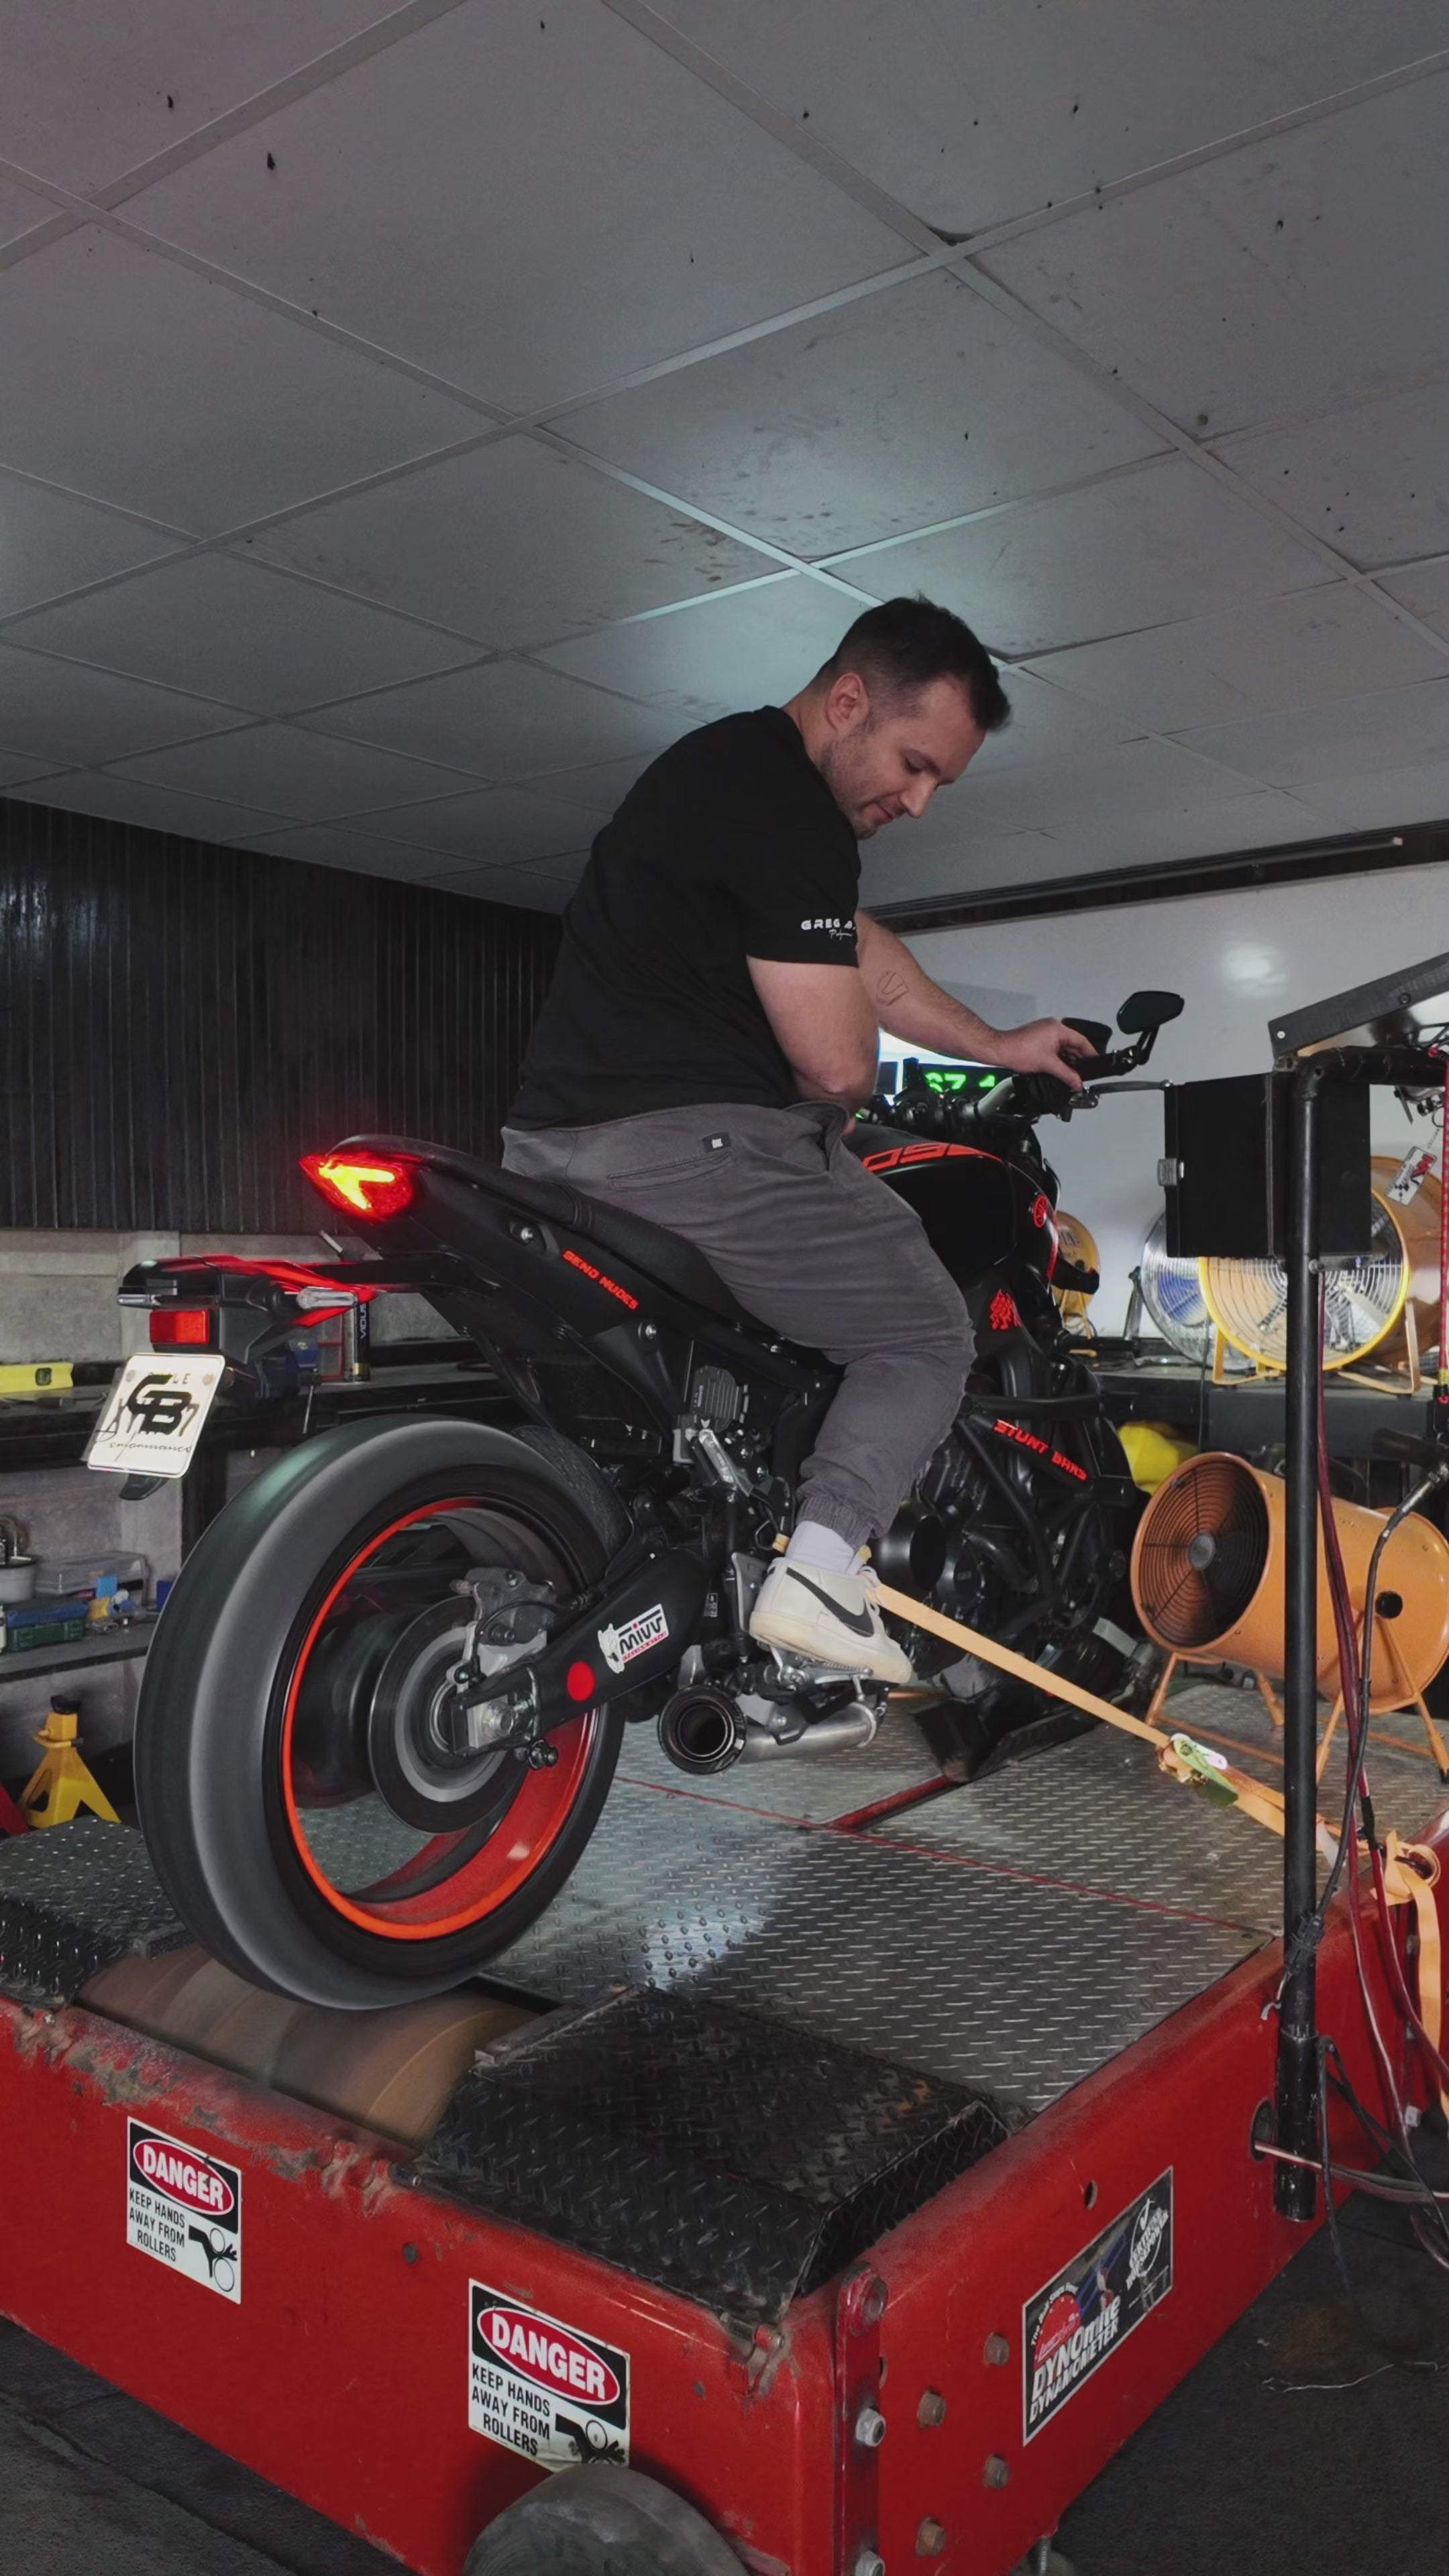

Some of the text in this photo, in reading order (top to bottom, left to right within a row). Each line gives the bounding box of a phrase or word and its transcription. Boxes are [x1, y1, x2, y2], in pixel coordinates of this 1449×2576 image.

[801, 918, 841, 930] GREG
[563, 1250, 639, 1310] SEND NUDES
[994, 1418, 1087, 1481] STUNT BARS
[143, 2143, 223, 2210] DANGER
[129, 2188, 185, 2229] KEEP HANDS
[129, 2206, 184, 2248] AWAY FROM
[137, 2229, 176, 2263] ROLLERS
[492, 2312, 606, 2400] DANGER
[1029, 2316, 1120, 2424] DYNAMOMETER
[472, 2362, 551, 2417] KEEP HANDS
[472, 2385, 508, 2418] AWAY
[513, 2406, 550, 2440] FROM
[483, 2412, 537, 2457] ROLLERS
